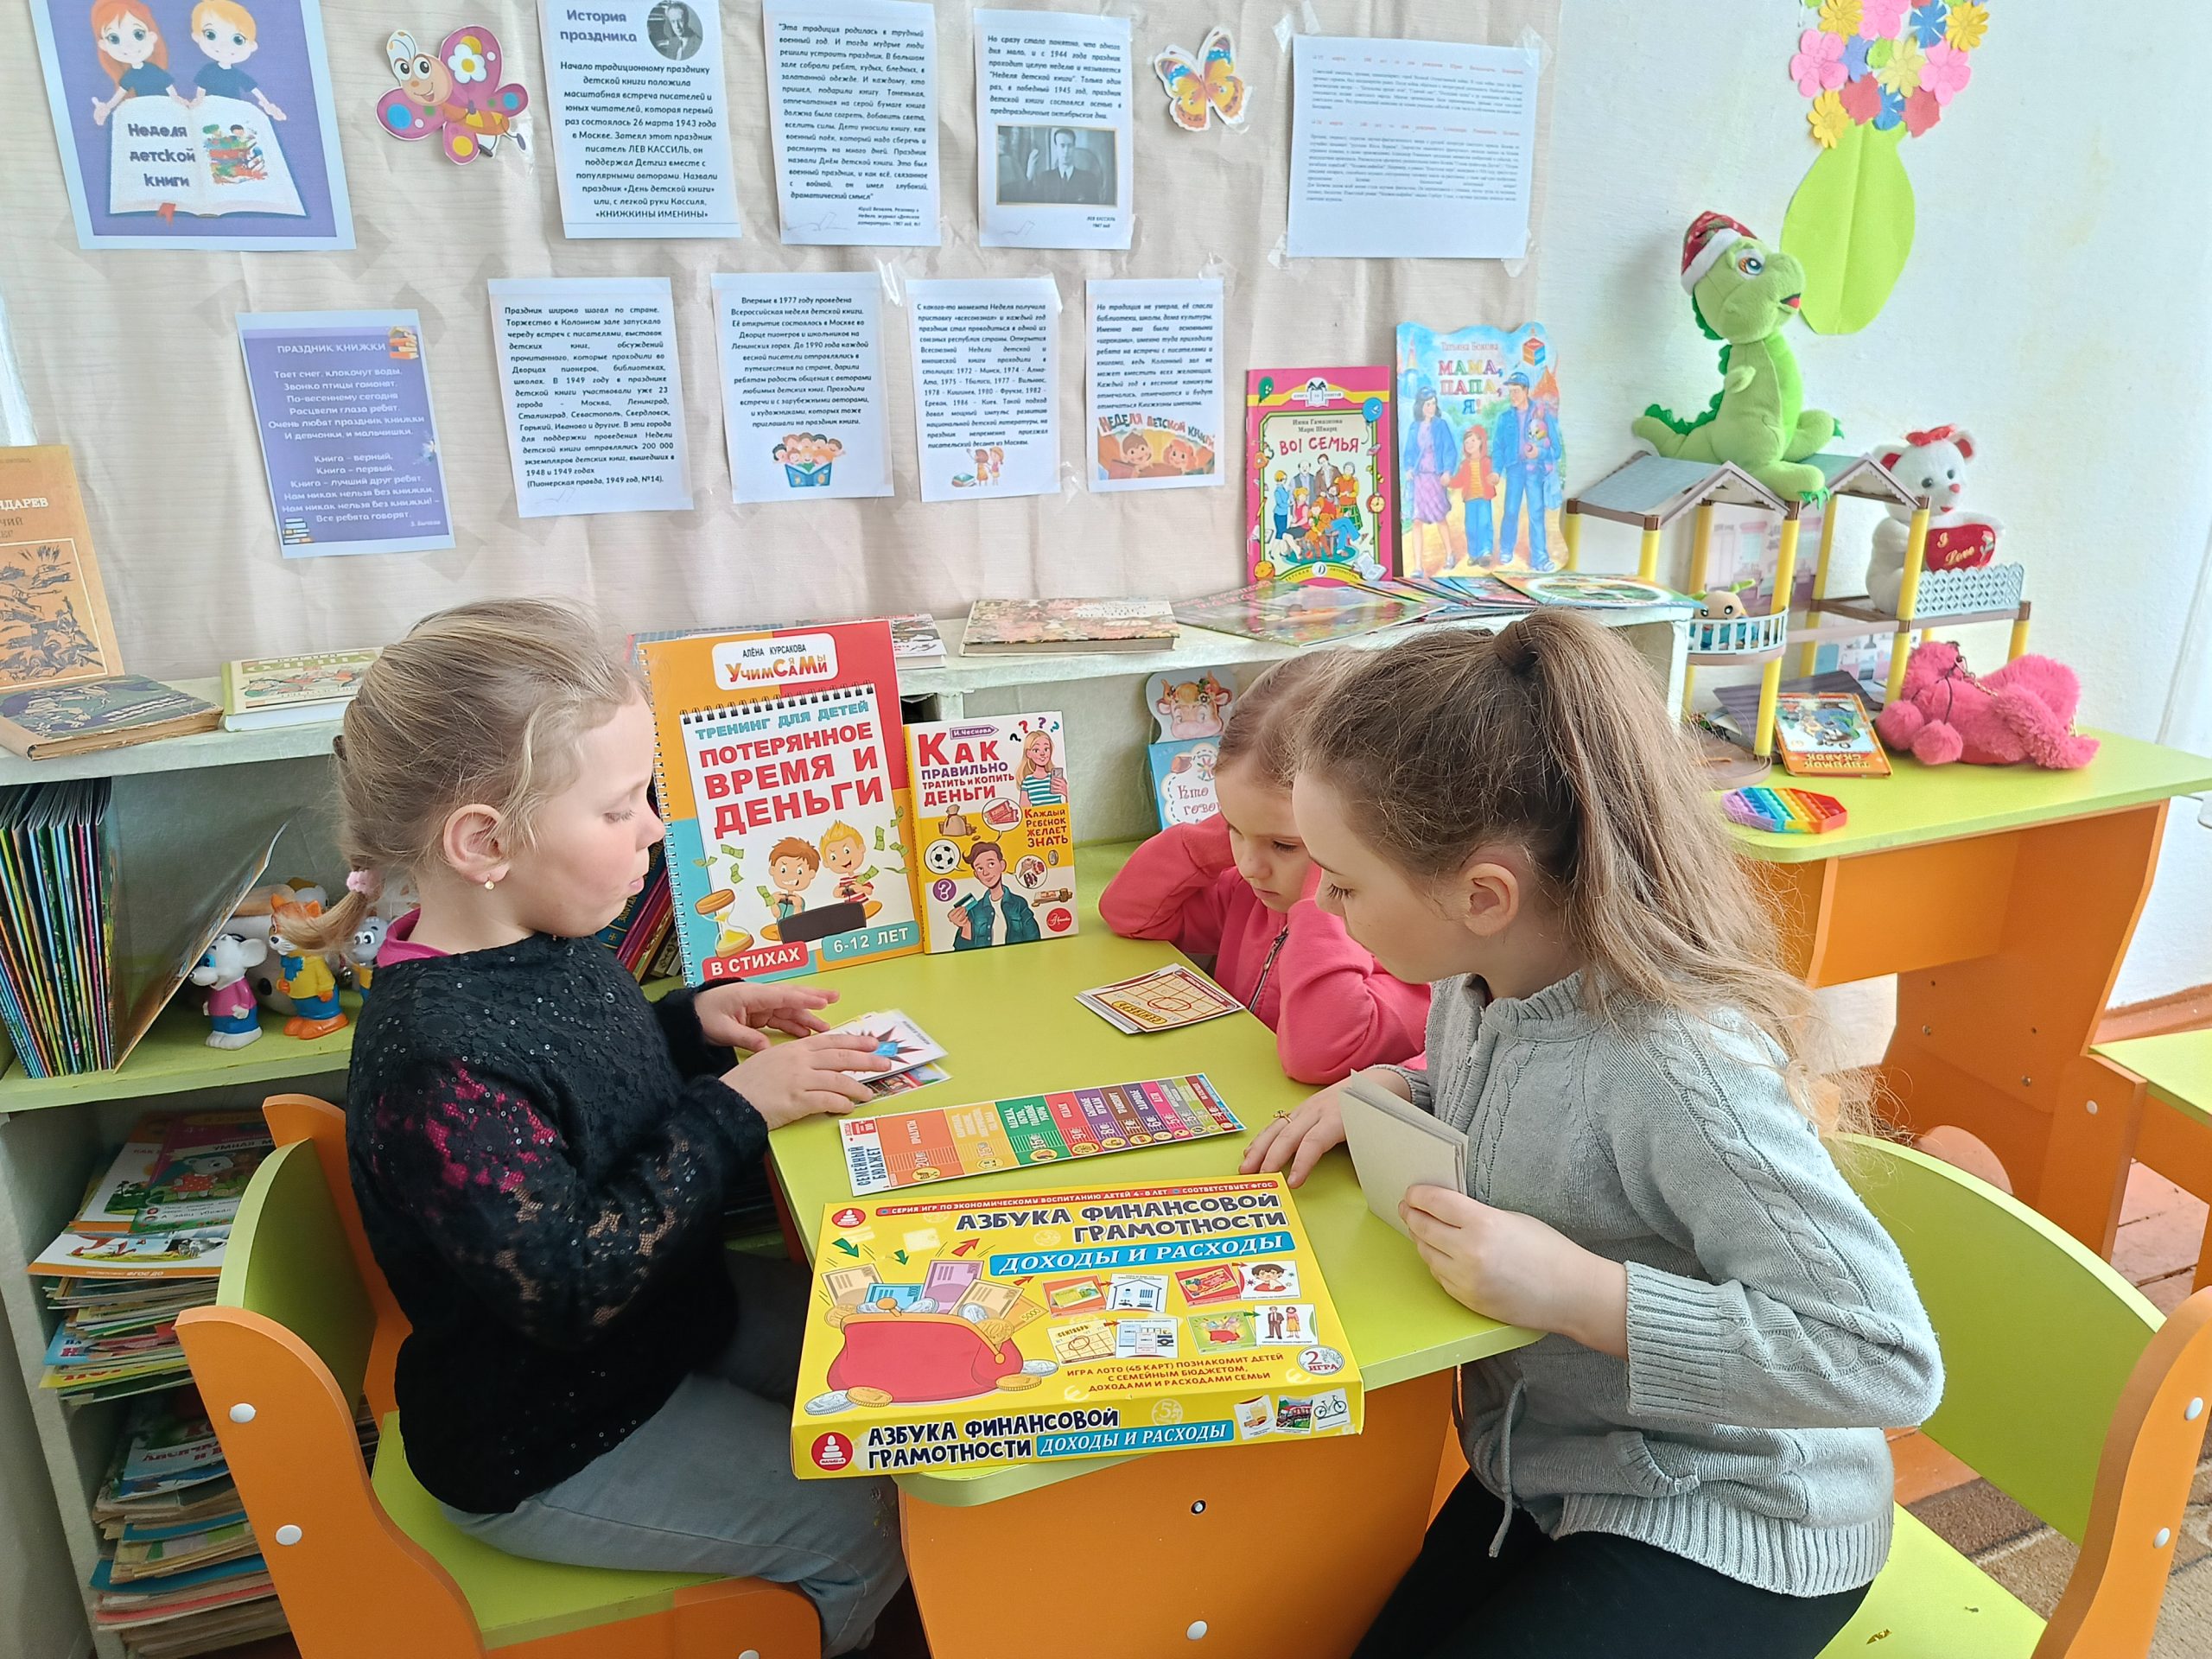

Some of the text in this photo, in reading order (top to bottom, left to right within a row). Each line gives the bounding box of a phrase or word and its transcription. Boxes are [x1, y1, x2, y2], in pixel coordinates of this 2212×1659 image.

[567, 10, 626, 24] История
[560, 30, 638, 43] праздника
[560, 60, 709, 74] Начало традиционному празднику
[582, 75, 620, 85] детской
[563, 90, 620, 99] масштабная
[128, 123, 188, 137] Неделя
[632, 118, 643, 126] 26
[676, 118, 696, 127] 1943
[130, 149, 196, 162] детской
[647, 145, 691, 154] КАССИЛЬ,
[143, 173, 190, 187] книги
[815, 296, 851, 304] проведена
[504, 306, 542, 315] Праздник
[731, 308, 783, 316] Всероссийская
[505, 318, 551, 327] Торжество
[276, 342, 385, 353] ПРАЗДНИК КНИЖКИ
[1438, 359, 1503, 378] МАМА,
[1440, 379, 1503, 397] ПАПА,
[1462, 399, 1482, 415] Я!
[1098, 413, 1142, 432] НЕДЕЛЯ
[1147, 416, 1185, 433] ДЕТСКОЙ
[1308, 436, 1359, 454] СЕМЬЯ
[742, 644, 807, 658] АЛЁНА КУРСАКОВА
[695, 700, 869, 740] ТРЕНИНГ ДЛЯ ДЕТЕЙ
[699, 722, 873, 768] ПОТЕРЯННОЕ
[704, 746, 878, 800] ВРЕМЯ И
[921, 761, 1008, 779] ПРАВИЛЬНО
[923, 779, 966, 790] ТРАТИТЬ
[975, 773, 1014, 785] КОПИТЬ
[924, 785, 996, 807] ДЕНЬГИ
[1177, 785, 1209, 800] Кто
[714, 776, 884, 840] ДЕНЬГИ
[1027, 826, 1067, 836] ЖЕЛАЕТ
[1027, 835, 1069, 849] ЗНАТЬ
[833, 927, 909, 954] 6-12 ЛЕТ
[710, 948, 801, 976] В СТИХАХ
[848, 1146, 871, 1185] СЕМЕЙНЫЙ
[866, 1146, 887, 1180] БЮДЖЕТ
[1182, 1184, 1249, 1194] СООТВЕТСТВУЕТ
[954, 1198, 1039, 1210] ЭКОНОМИЧЕСКОМУ
[1040, 1193, 1102, 1203] ВОСПИТАНИЮ
[1103, 1191, 1132, 1199] ДЕТЕЙ
[956, 1192, 1281, 1230] АЗБУКА ФИНАНСОВОЙ
[1075, 1211, 1287, 1243] ГРАМОТНОСТИ
[999, 1234, 1283, 1274] ДОХОДЫ И РАСХОДЫ
[1021, 1308, 1042, 1322] 5000
[1057, 1325, 1089, 1338] СЕНТЯБРЬ
[1144, 1362, 1173, 1370] КАРТ)
[1177, 1357, 1248, 1369] ПОЗНАКОМИТ
[1251, 1353, 1284, 1363] ДЕТЕЙ
[1305, 1351, 1322, 1365] 2
[1116, 1371, 1179, 1381] СЕМЕЙНЫМ
[1182, 1367, 1248, 1376] БЮДЖЕТОМ,
[1308, 1363, 1339, 1372] ИГРА
[1089, 1382, 1151, 1393] ДОХОДАМИ
[1165, 1377, 1234, 1386] РАСХОДАМИ
[1236, 1372, 1270, 1382] СЕМЬИ
[868, 1407, 1118, 1446] АЗБУКА ФИНАНСОВОЙ
[1040, 1424, 1227, 1455] ДОХОДЫ И РАСХОДЫ
[868, 1440, 1031, 1469] ГРАМОТНОСТИ
